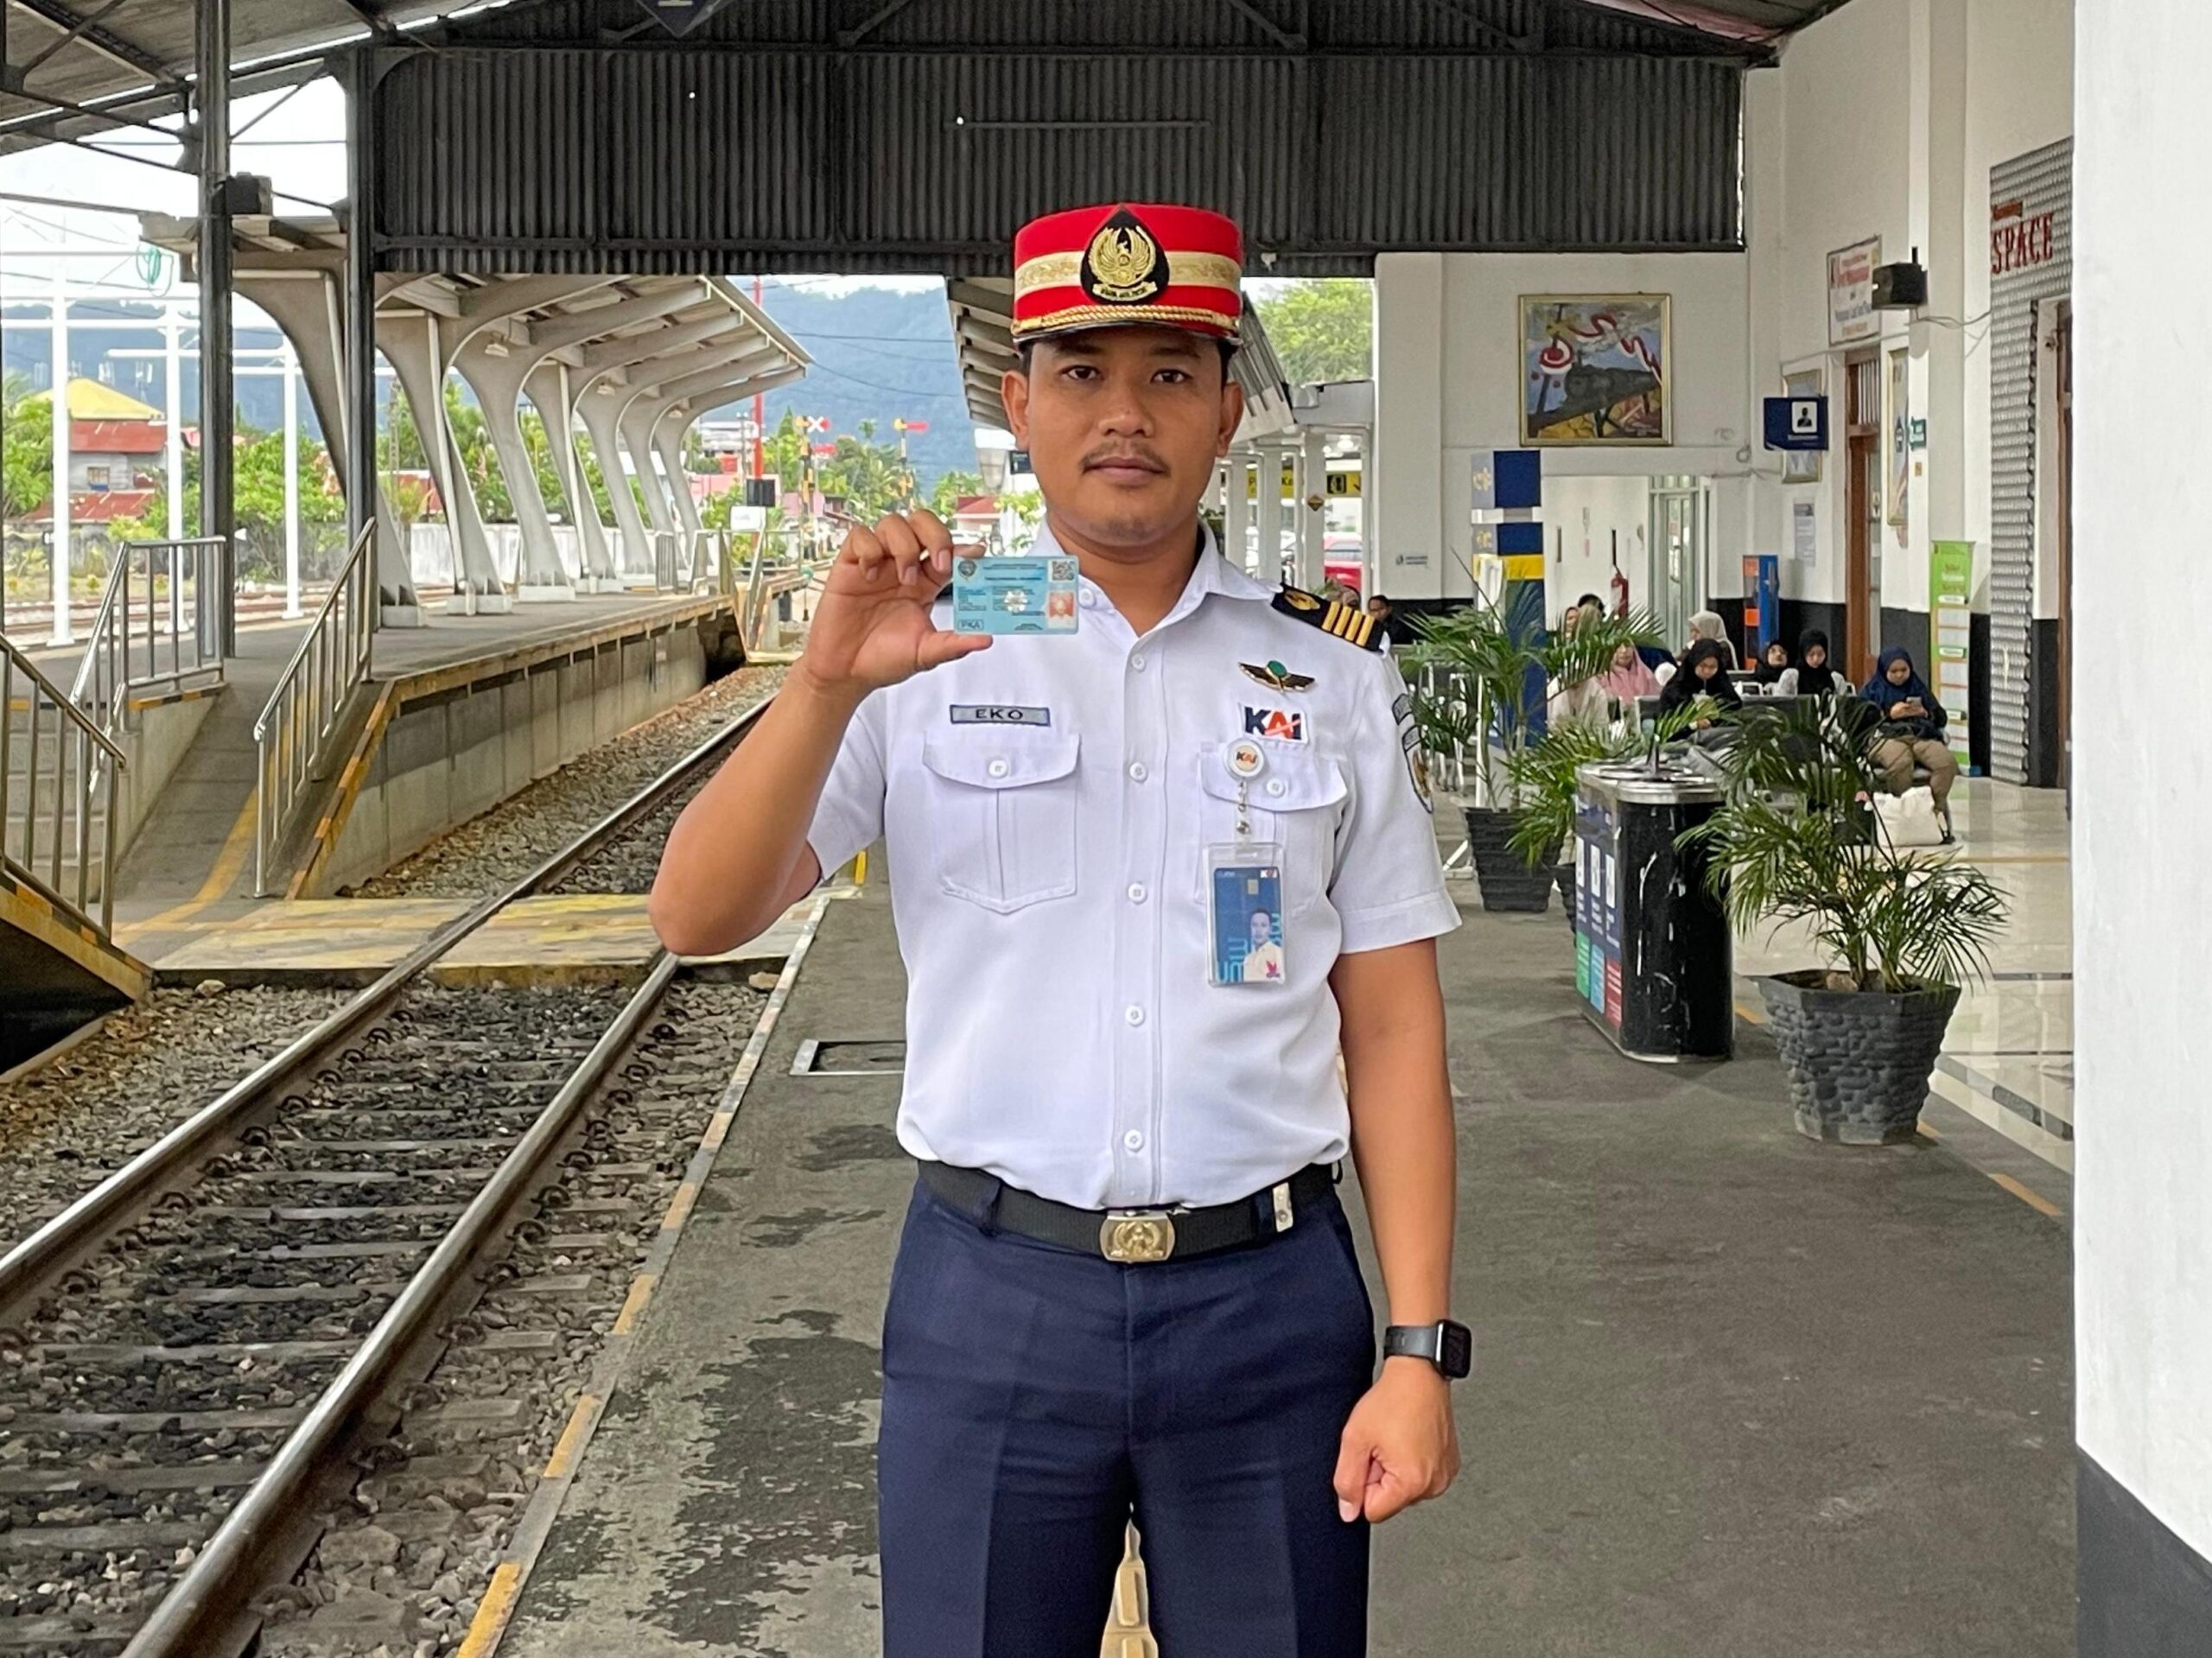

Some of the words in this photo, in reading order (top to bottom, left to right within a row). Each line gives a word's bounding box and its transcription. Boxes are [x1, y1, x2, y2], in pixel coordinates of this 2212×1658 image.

[1992, 213, 2053, 274] SPACE
[976, 708, 1023, 720] EKO
[1244, 706, 1301, 740] KAI
